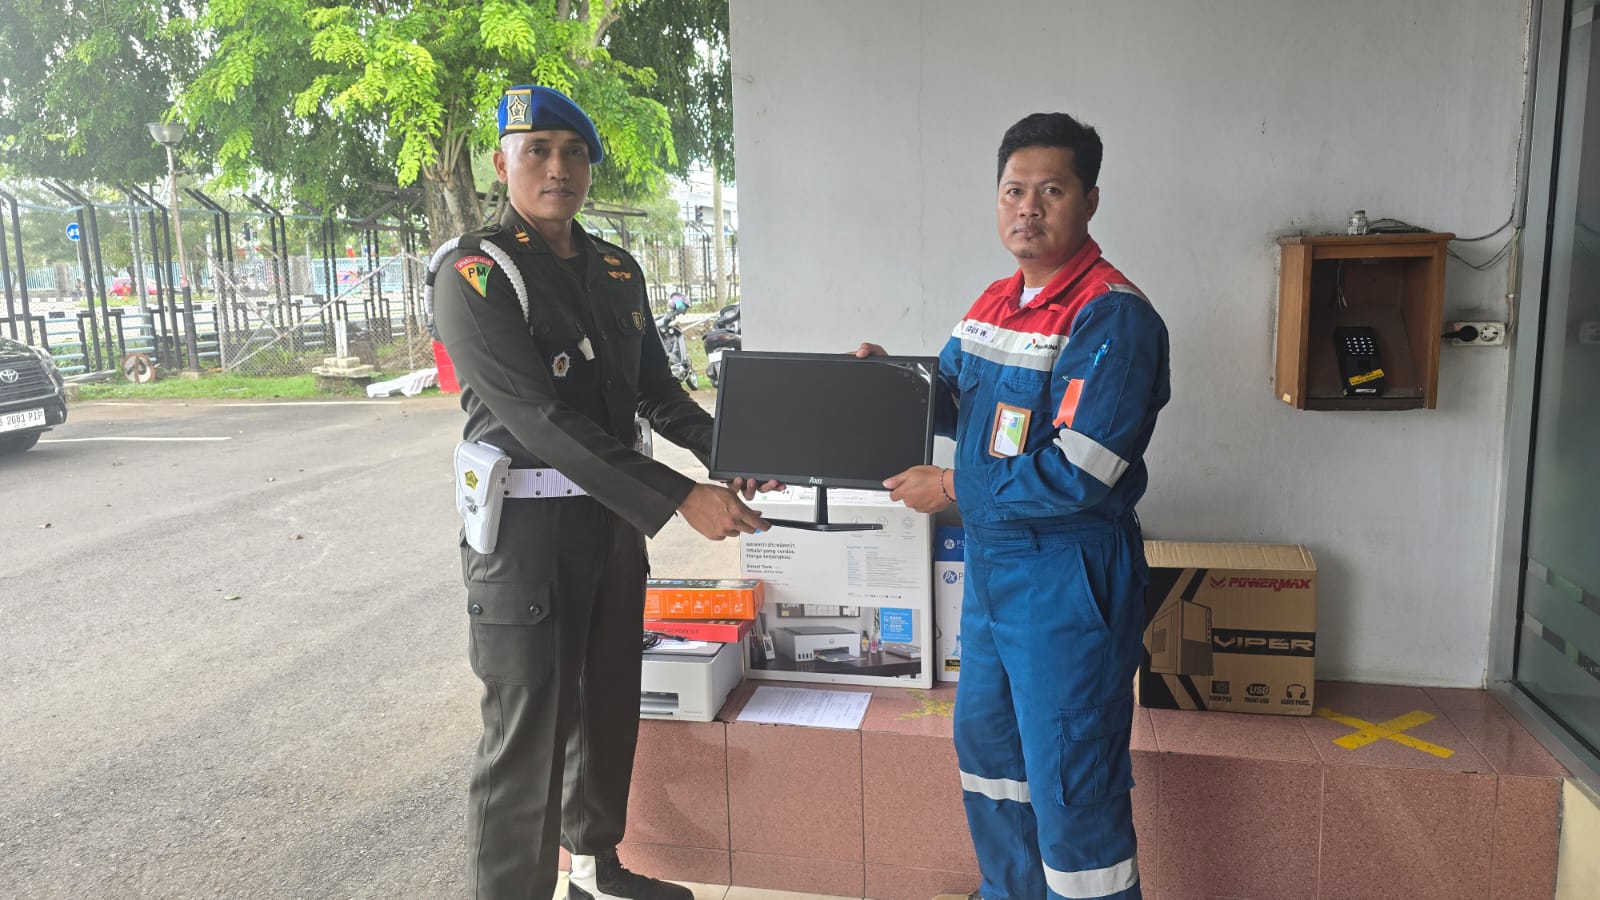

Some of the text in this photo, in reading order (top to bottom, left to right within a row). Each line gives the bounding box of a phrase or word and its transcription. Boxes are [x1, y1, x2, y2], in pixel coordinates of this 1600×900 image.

[468, 266, 486, 278] PM
[1228, 576, 1312, 592] POWERMAX
[1213, 635, 1314, 651] VIPER
[1249, 685, 1269, 695] USB
